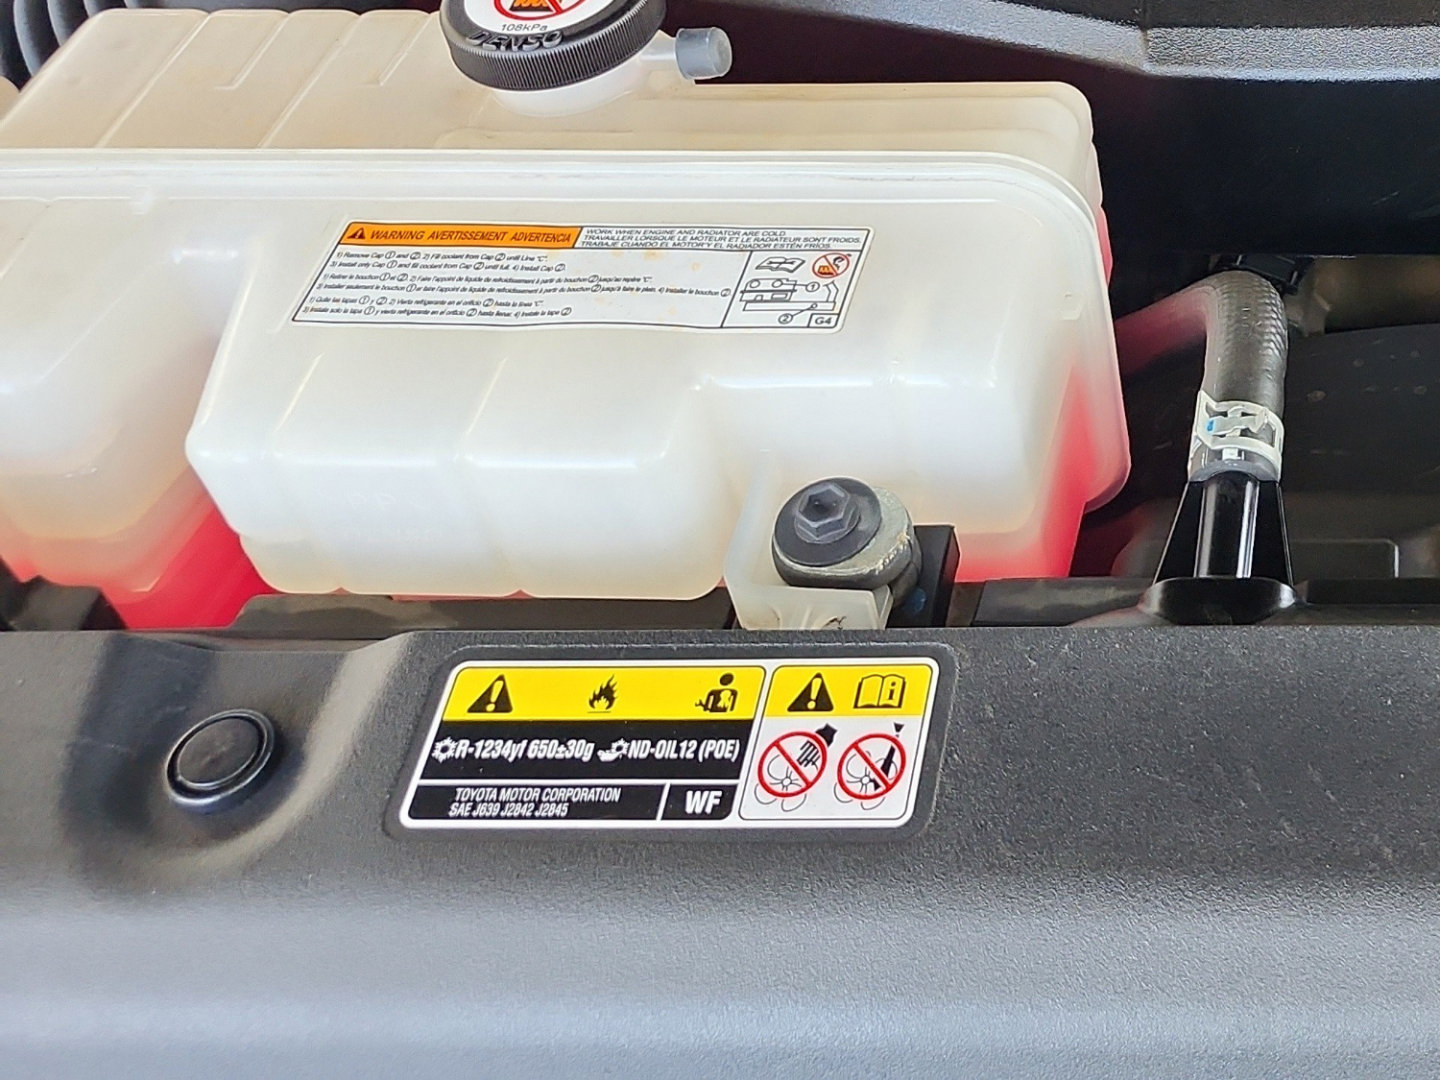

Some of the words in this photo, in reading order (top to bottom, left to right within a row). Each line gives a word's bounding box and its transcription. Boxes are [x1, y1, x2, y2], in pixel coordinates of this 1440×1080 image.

[501, 23, 549, 32] 108kPa
[467, 30, 563, 52] DENSO
[370, 228, 425, 241] WARNING
[427, 230, 509, 242] AVERTISSEMENT
[511, 232, 572, 244] ADVERTENCIA
[814, 316, 832, 325] G4
[455, 738, 529, 763] R-1234yf
[527, 738, 596, 763] 650±30g
[698, 738, 741, 763] (POE)
[455, 787, 499, 802] TOYOTA
[499, 787, 541, 802] MOTOR
[541, 787, 622, 802] CORPORATION
[685, 789, 724, 815] WF
[448, 802, 474, 818] SAE
[471, 802, 501, 818] J639
[500, 802, 536, 818] J2842
[534, 802, 570, 818] J2845
